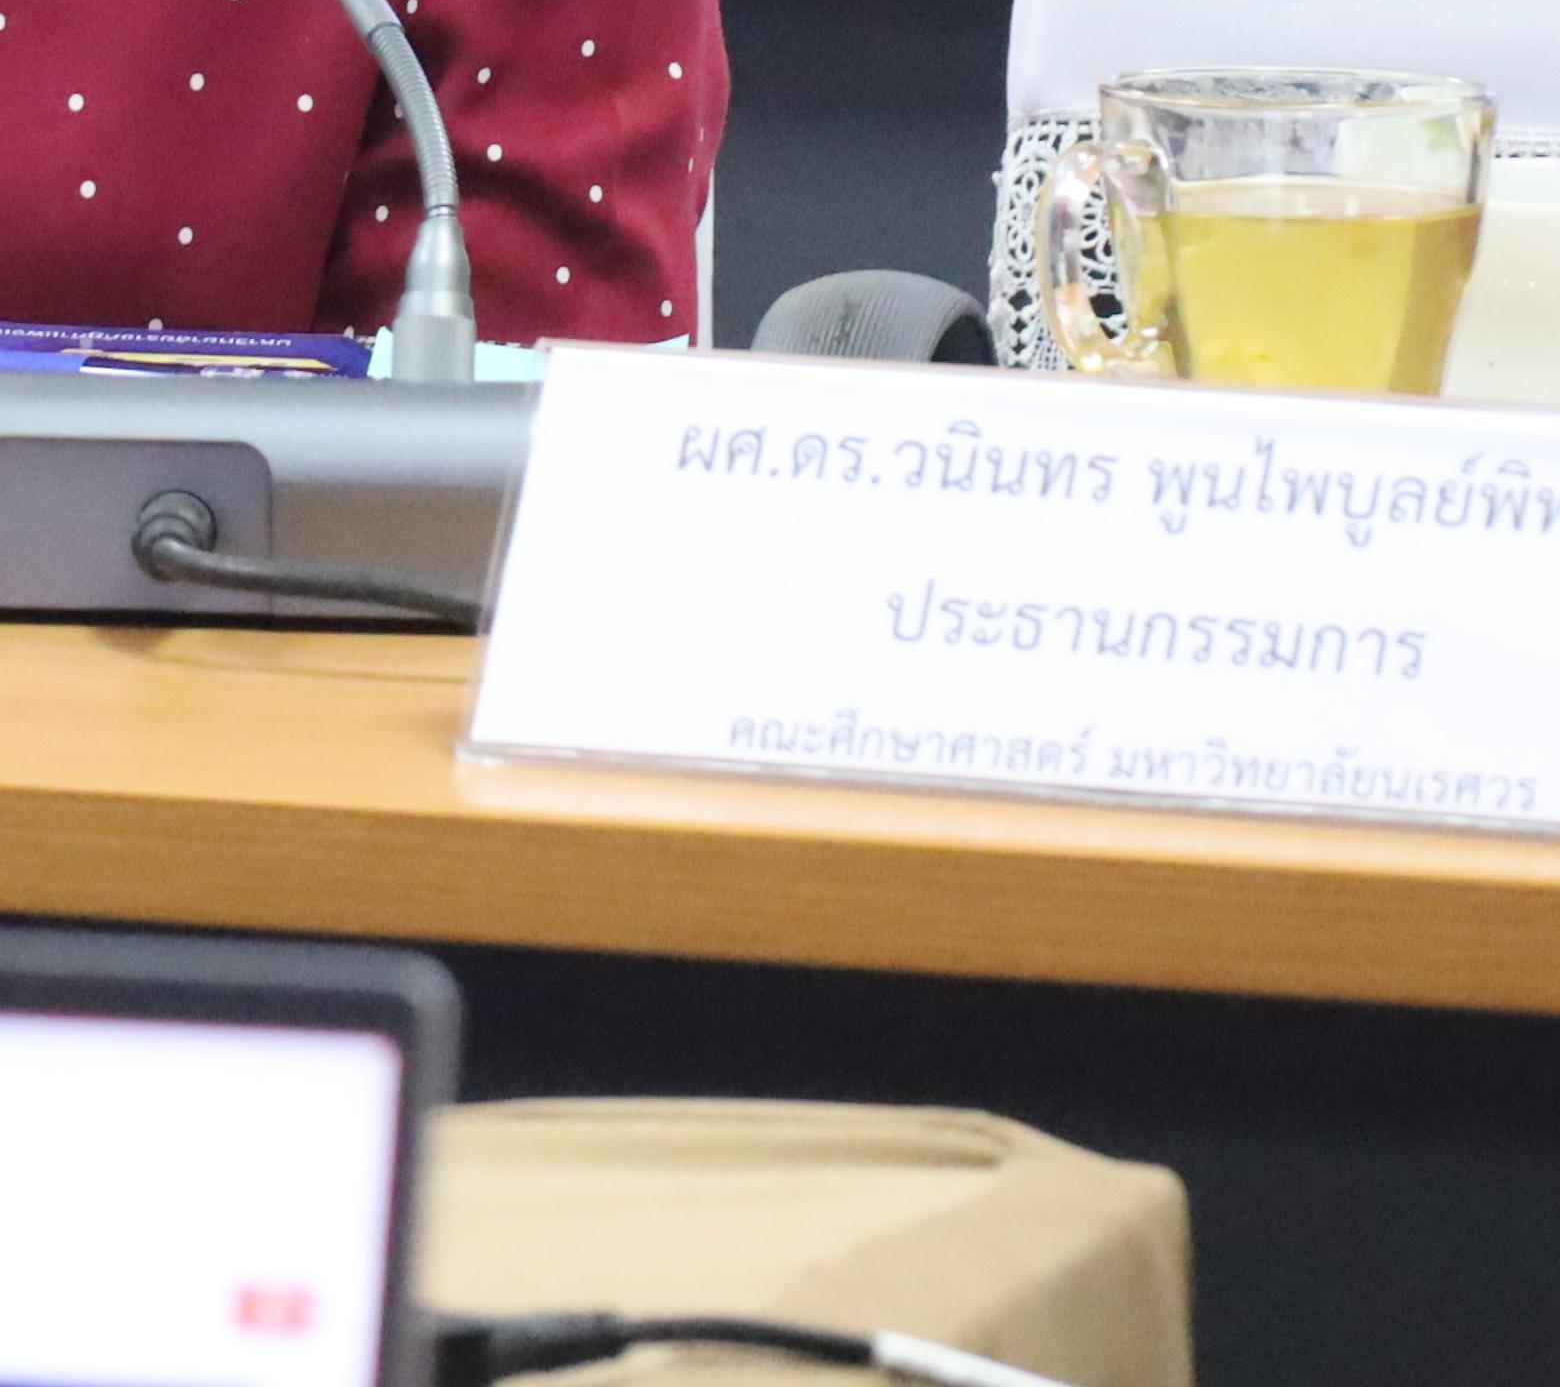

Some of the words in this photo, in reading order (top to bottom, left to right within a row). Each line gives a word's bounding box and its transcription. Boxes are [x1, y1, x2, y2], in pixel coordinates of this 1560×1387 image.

[676, 419, 1119, 505] ผศ.ดร.วนินทร
[886, 579, 1429, 680] ประธานกรรมการ
[728, 708, 1095, 778] คณะศึกษาศาสตร์
[1108, 734, 1538, 812] มหาวิทยาลัยนเรศวร
